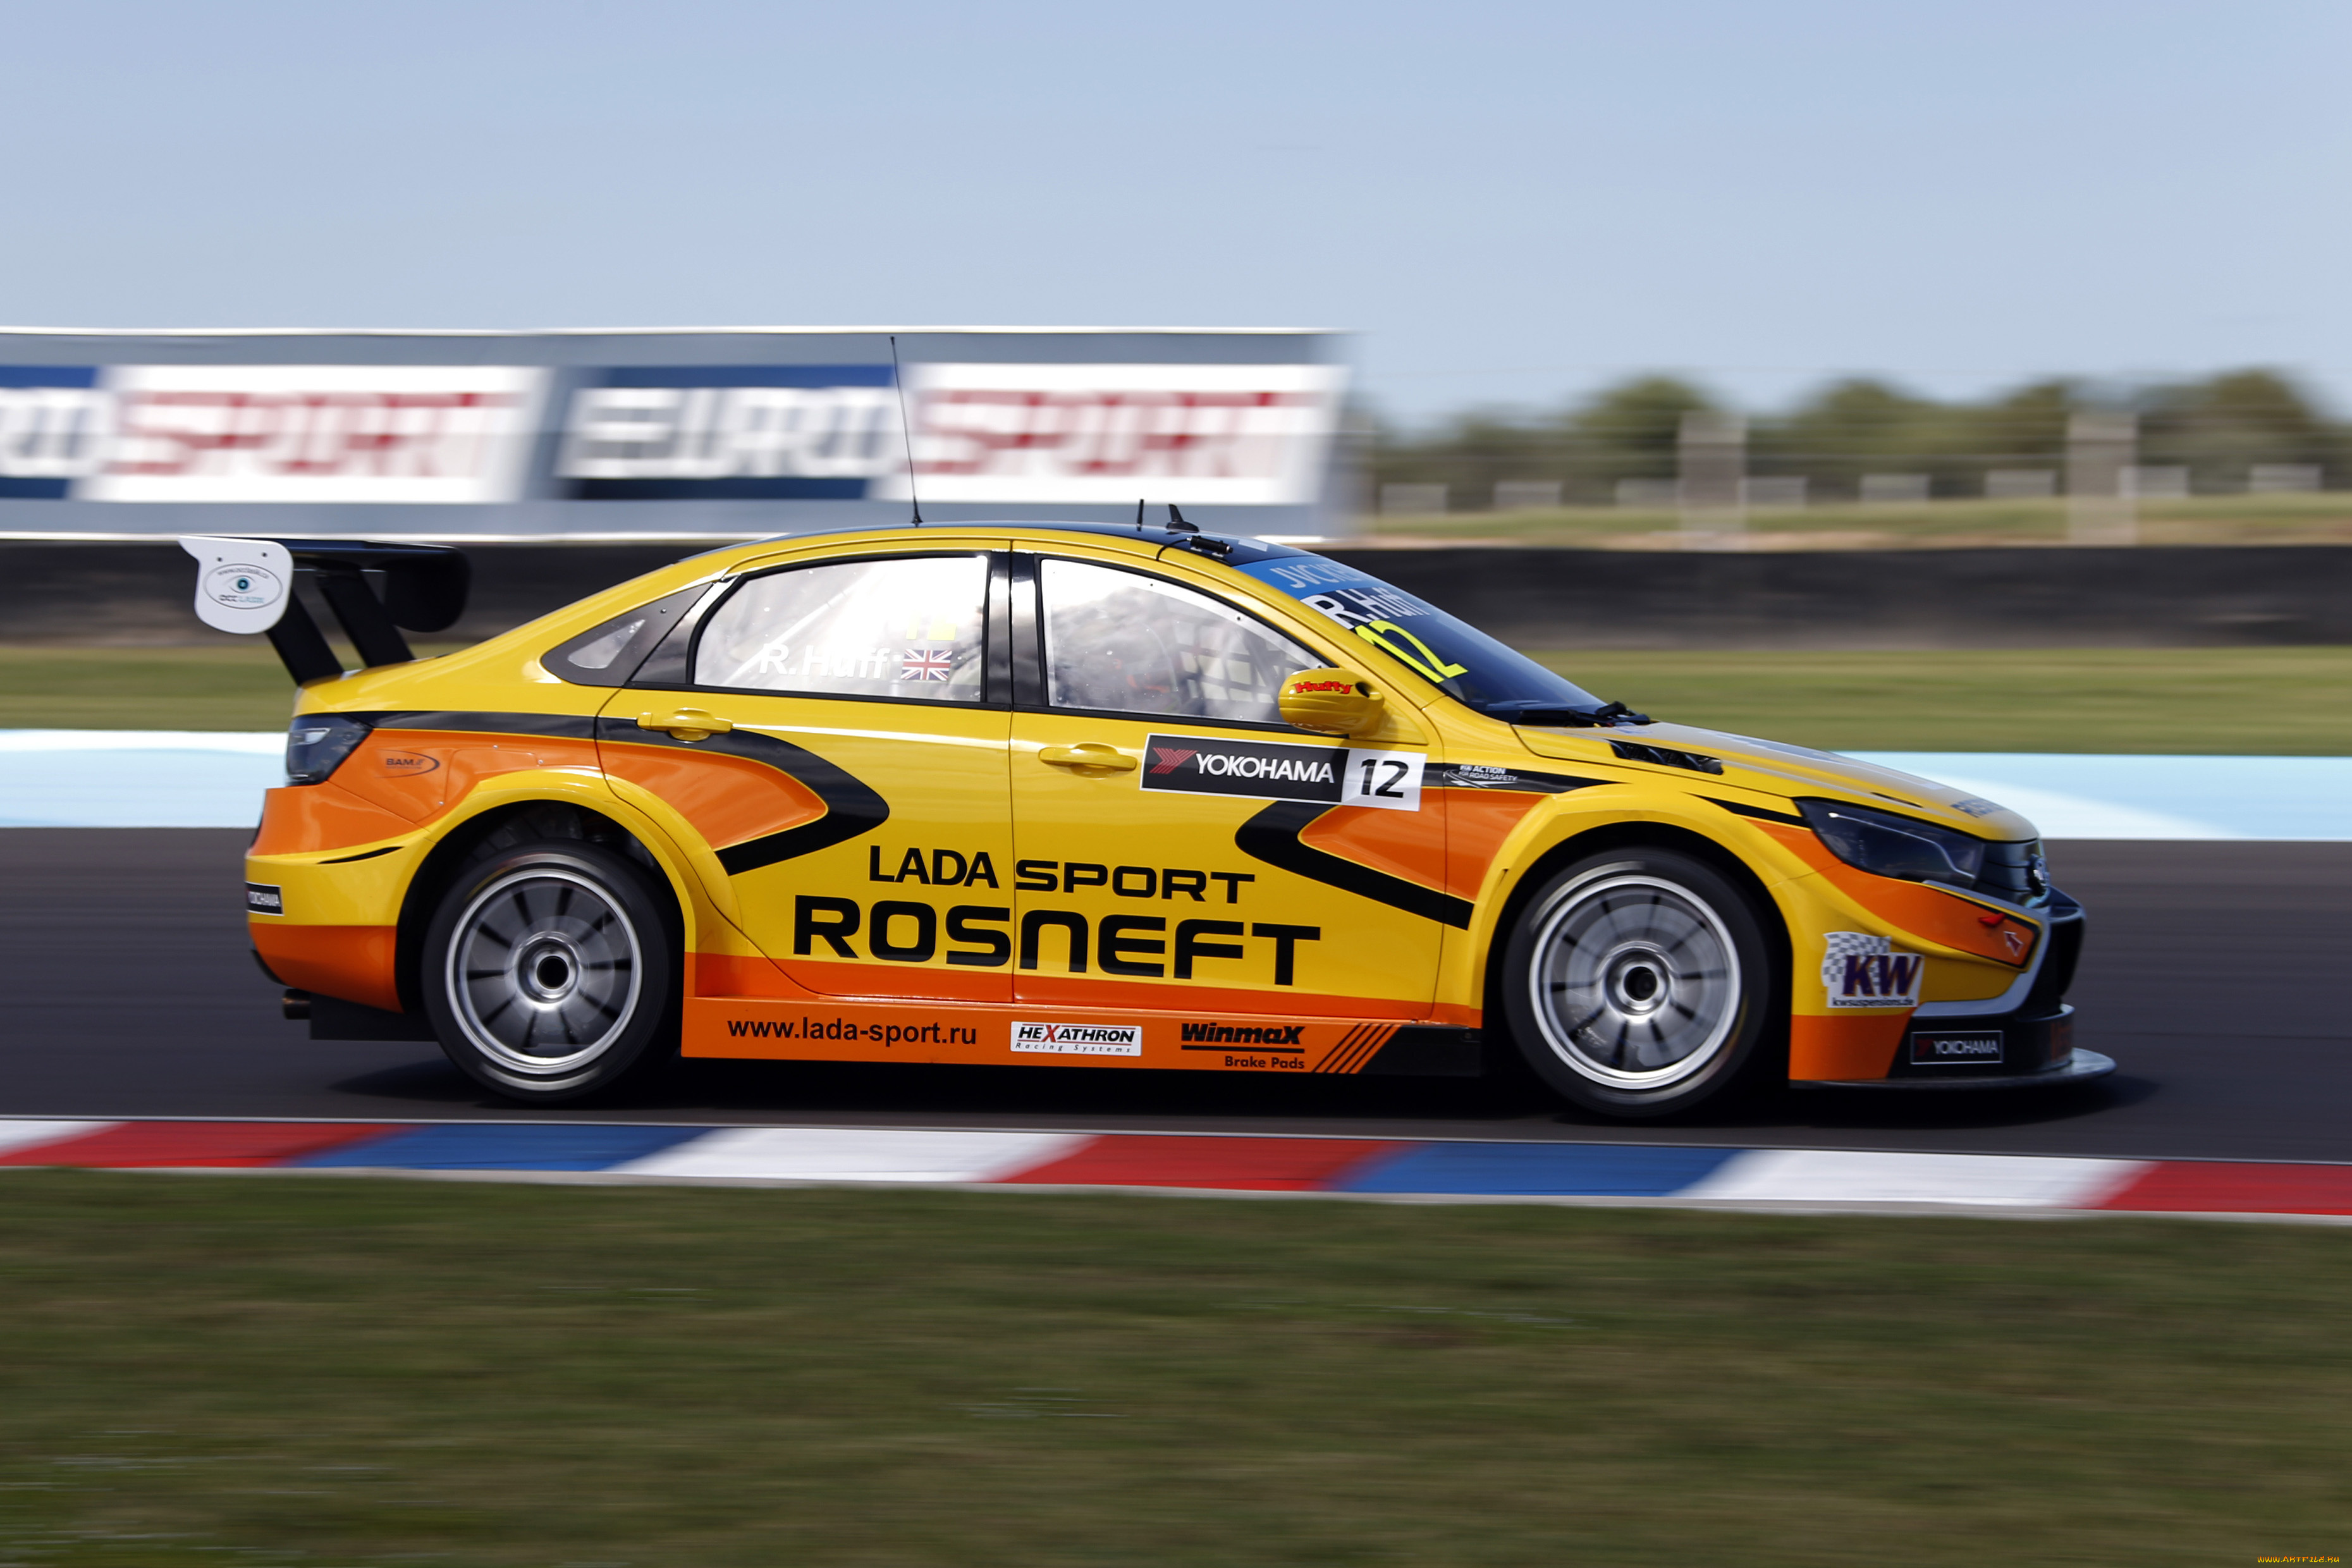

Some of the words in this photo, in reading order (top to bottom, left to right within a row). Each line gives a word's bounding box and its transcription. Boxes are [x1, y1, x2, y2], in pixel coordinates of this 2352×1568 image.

[1300, 587, 1431, 630] R.Huff
[759, 643, 890, 678] R.Huff
[1354, 620, 1468, 683] 12
[1291, 681, 1353, 695] Huffy
[1195, 753, 1335, 784] YOKOHAMA
[1359, 758, 1409, 798] 12
[1473, 766, 1507, 775] ACTION
[869, 845, 1000, 888] LADA
[1015, 859, 1256, 904] SPORT
[793, 894, 1321, 986] ROSNEFT
[1841, 955, 1923, 997] KW
[727, 1017, 977, 1047] www.lada-sport.ru
[1015, 1043, 1063, 1051] Racing
[1074, 1044, 1130, 1053] Systems
[1933, 1039, 1999, 1055] YOKOHAMA
[1225, 1056, 1266, 1068] Brake
[1271, 1057, 1305, 1069] Pads
